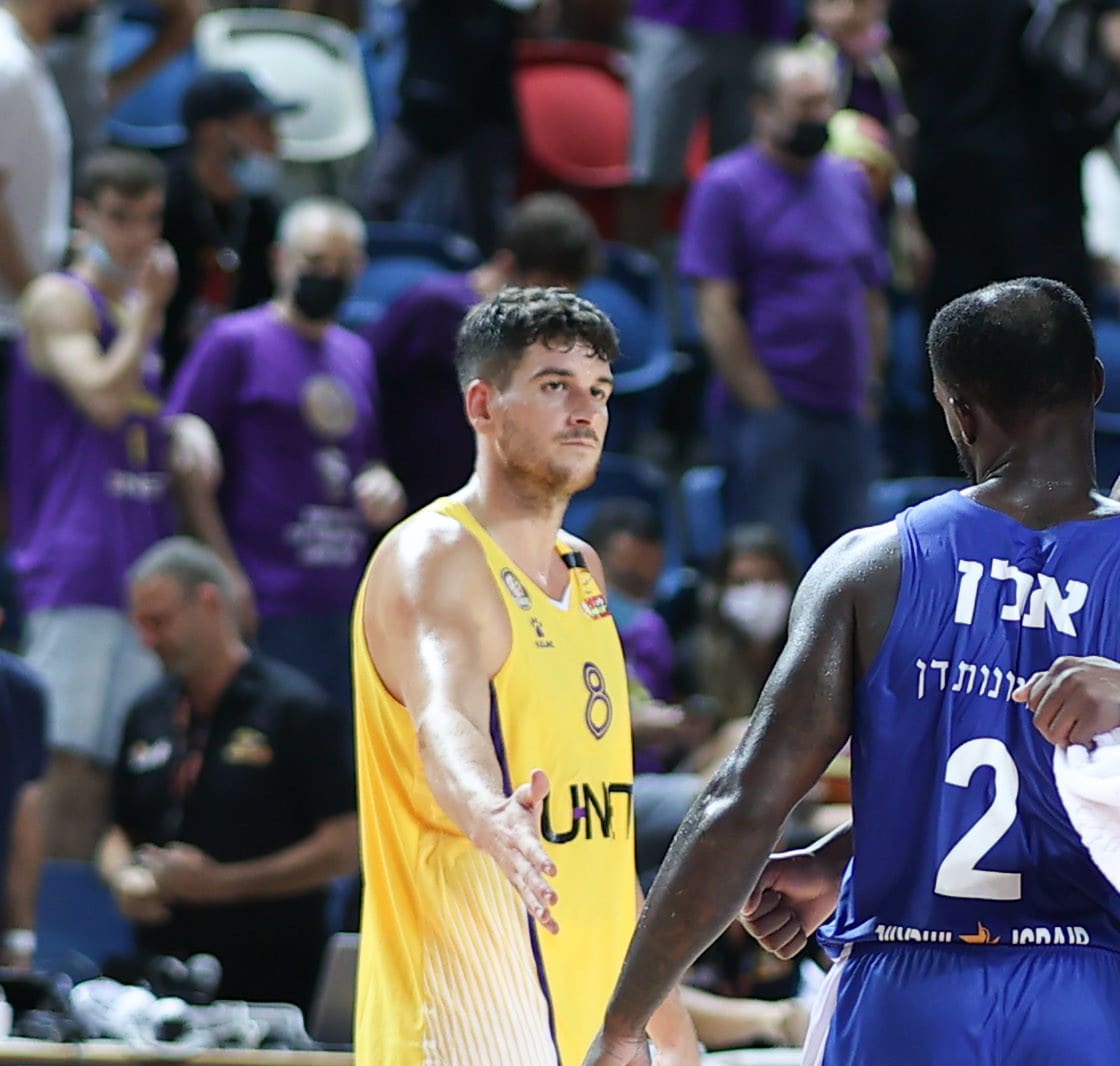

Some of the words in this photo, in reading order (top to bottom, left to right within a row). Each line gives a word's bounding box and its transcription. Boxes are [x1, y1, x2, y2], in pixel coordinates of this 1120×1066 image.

[582, 661, 613, 740] 8
[915, 658, 950, 700] דן
[541, 782, 633, 844] UNT
[934, 737, 1023, 900] 2
